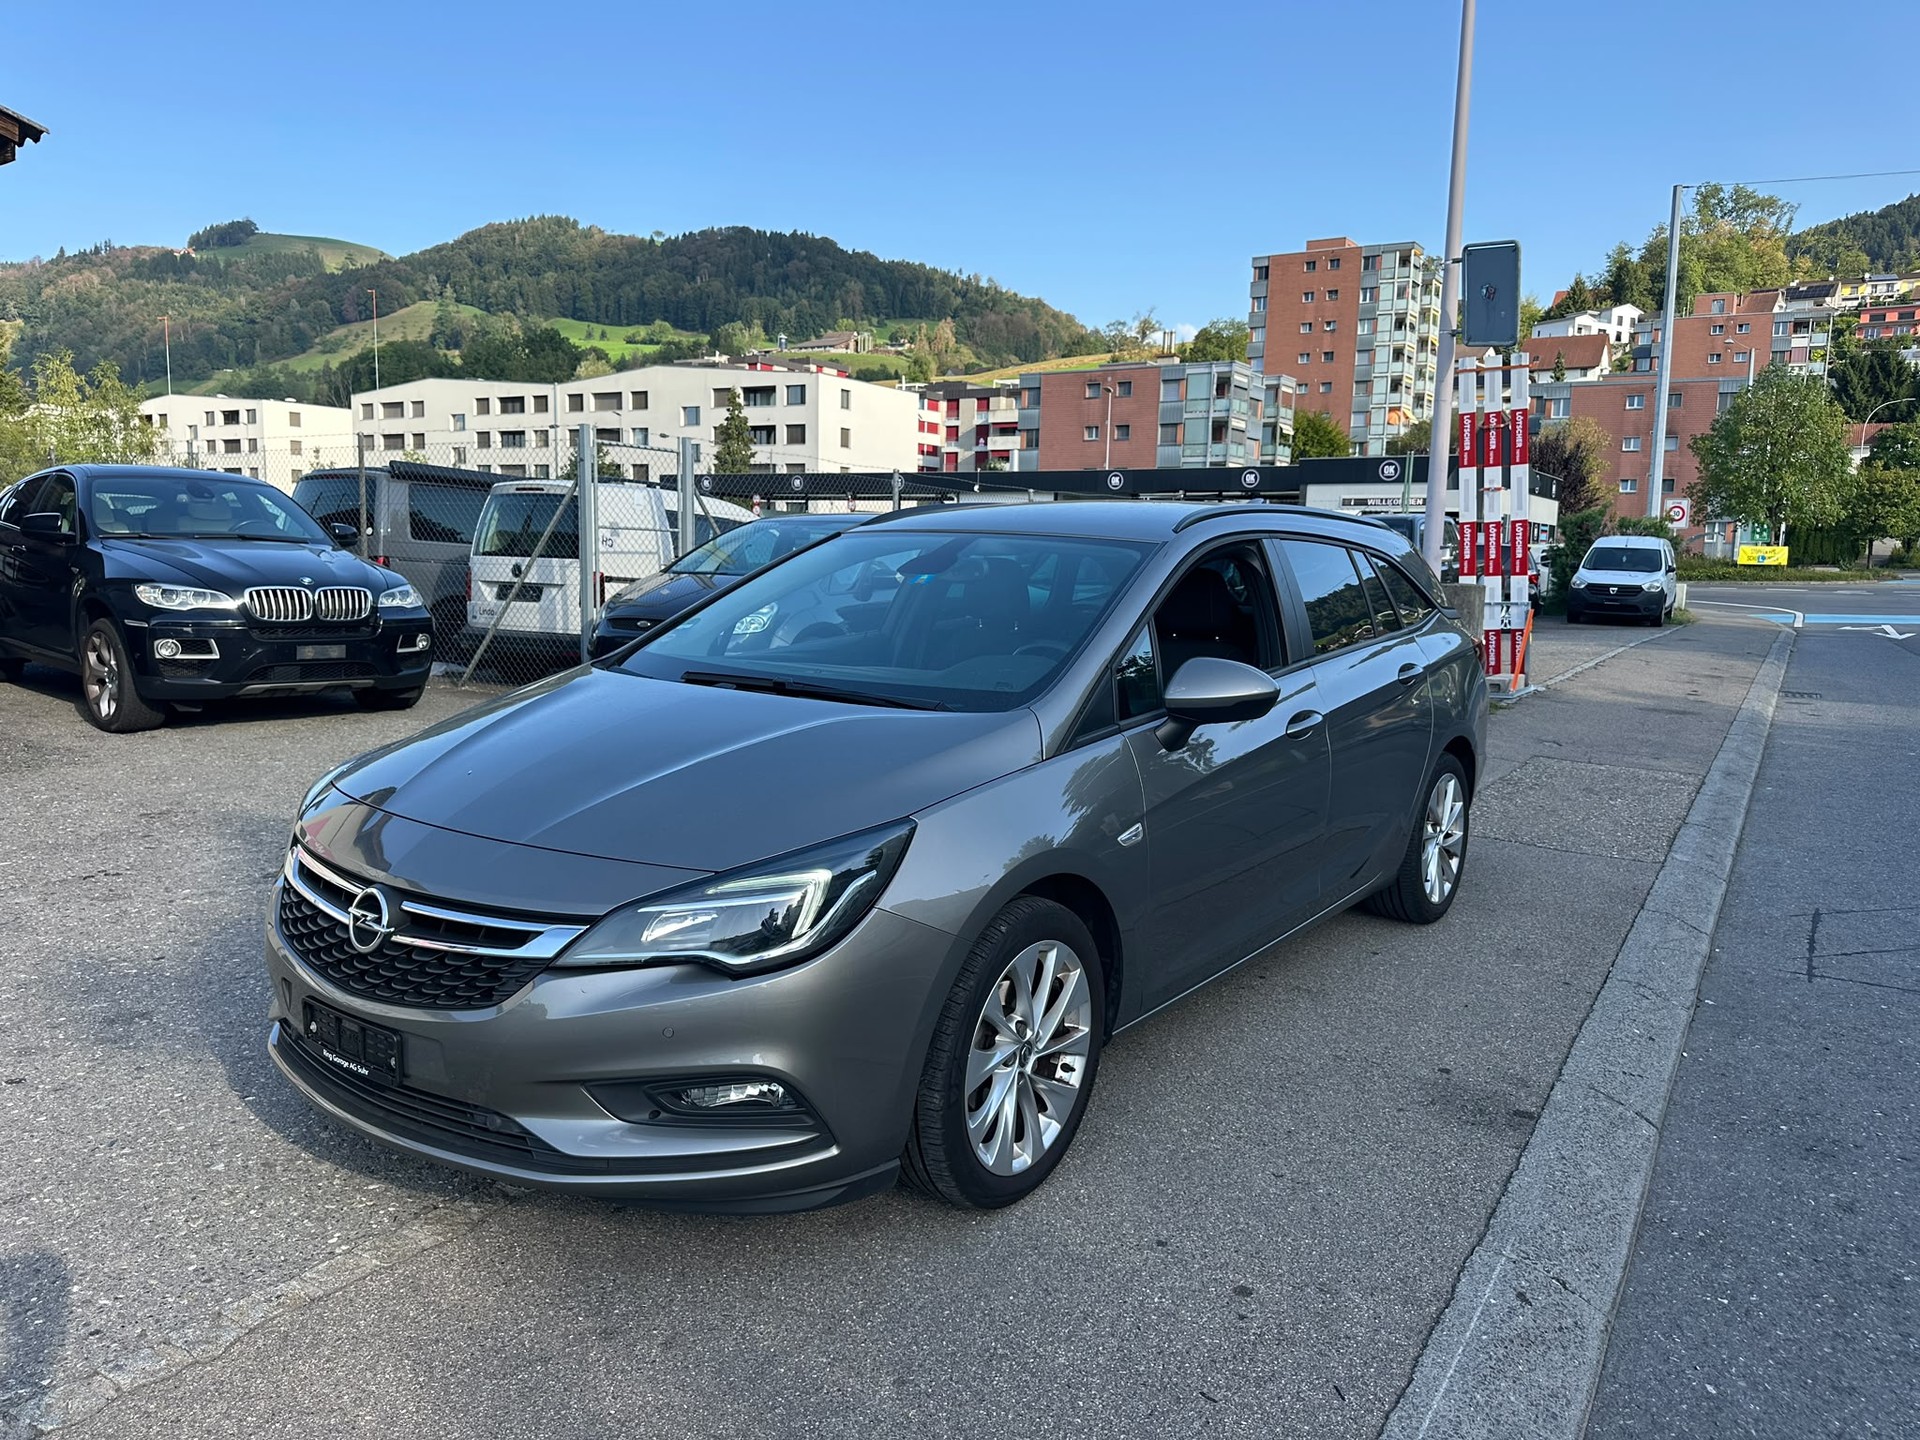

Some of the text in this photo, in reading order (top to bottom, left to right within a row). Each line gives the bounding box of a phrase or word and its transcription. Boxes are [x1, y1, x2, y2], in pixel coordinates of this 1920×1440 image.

[1463, 415, 1471, 451] LÖTSCHER
[1489, 413, 1497, 450] LÖCHER
[1516, 411, 1524, 448] LÖTSCHER
[1384, 465, 1395, 474] OK
[1463, 524, 1471, 559] LÖTSCHER
[1489, 524, 1497, 559] LÖTSCHER
[1516, 523, 1524, 558] LÖTSCHER
[323, 1049, 332, 1061] Ring
[333, 1054, 349, 1068] Garage
[350, 1063, 357, 1071] AG
